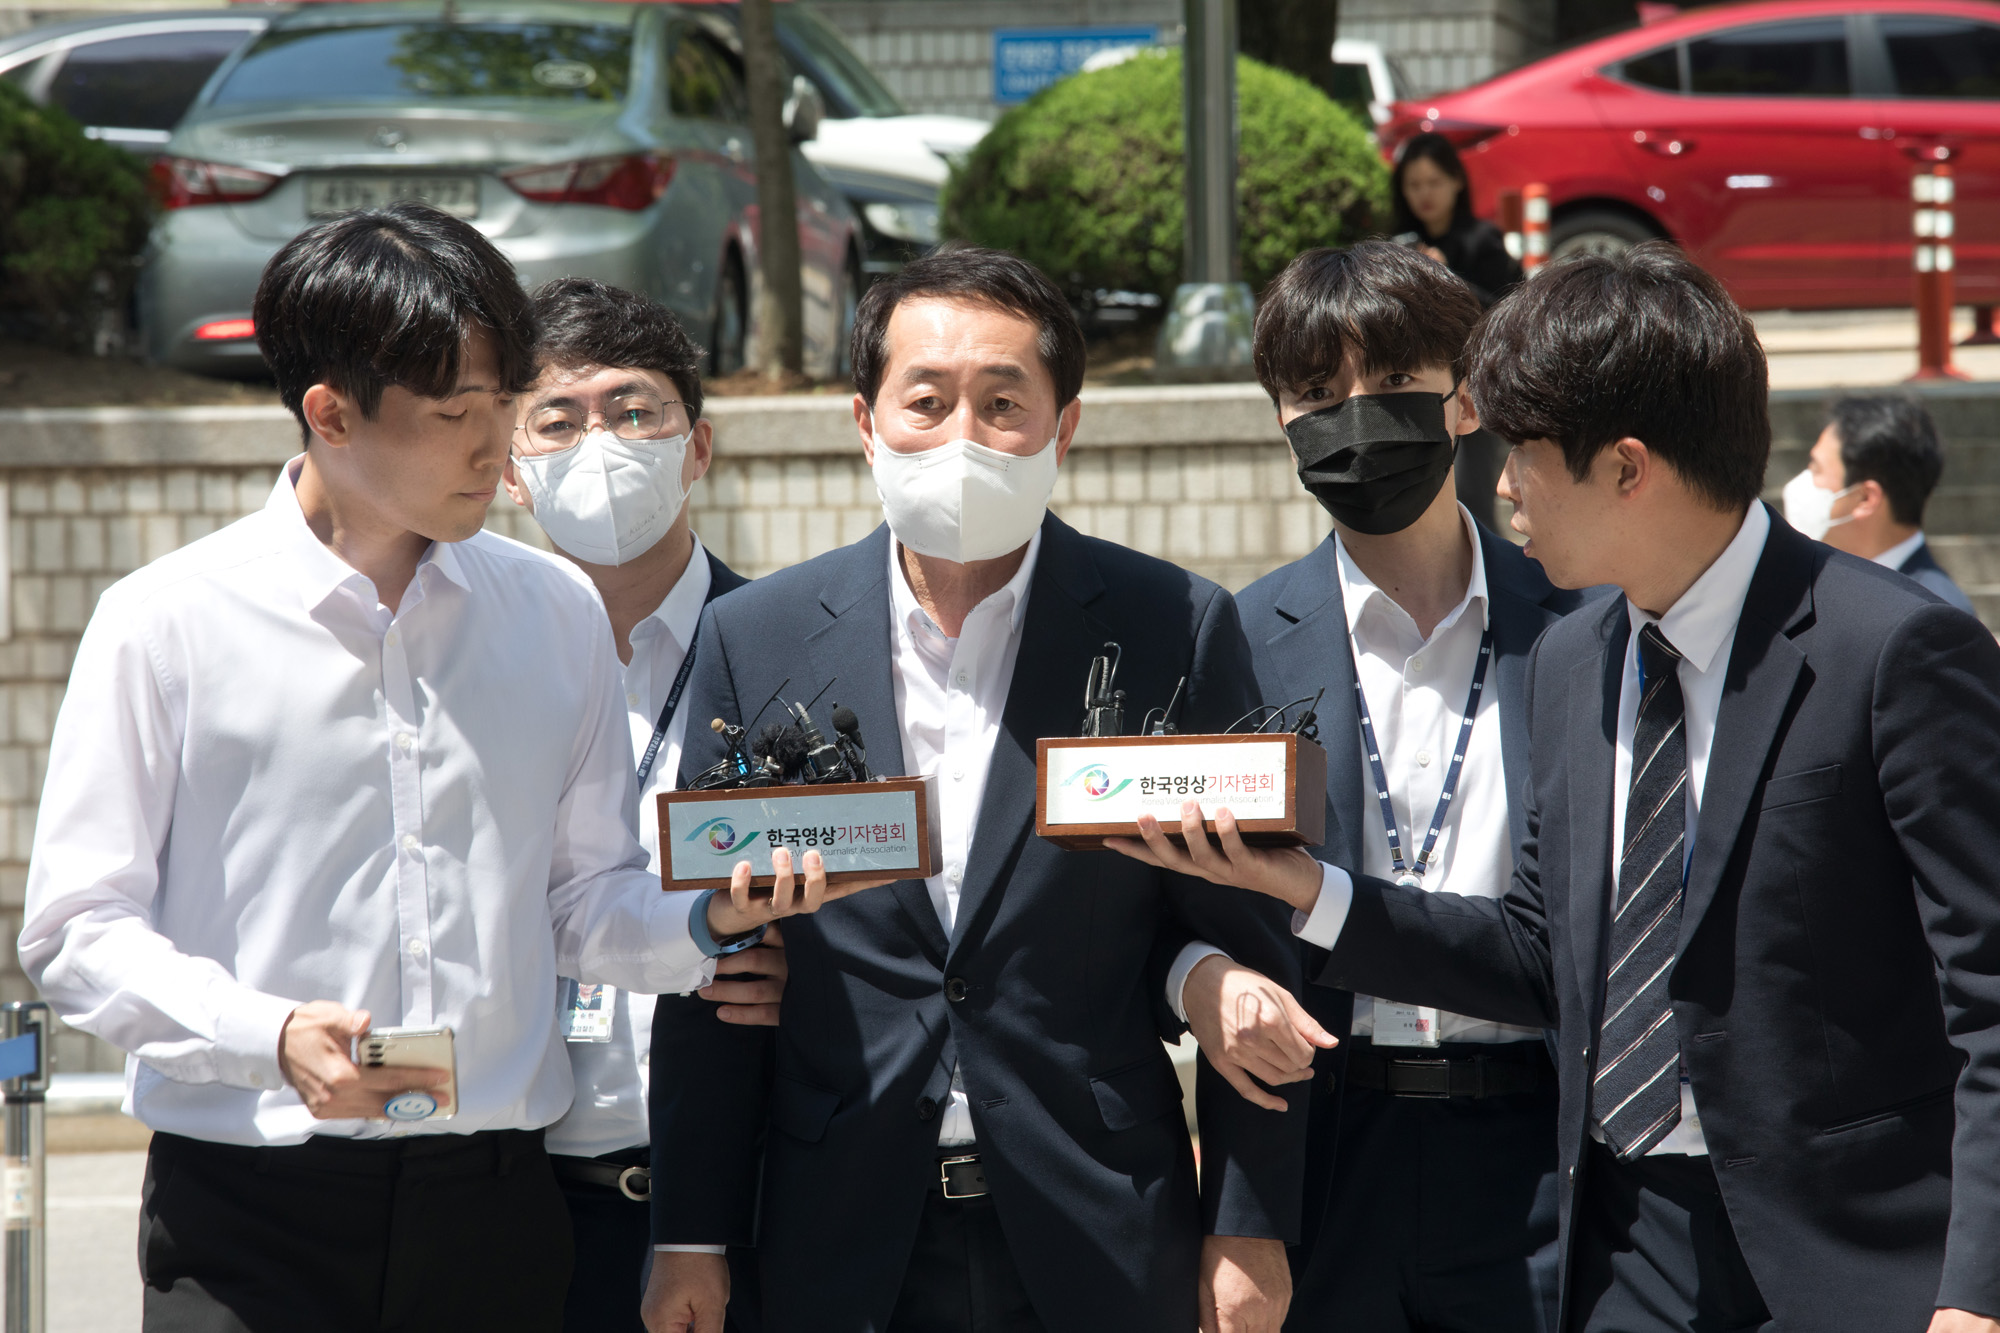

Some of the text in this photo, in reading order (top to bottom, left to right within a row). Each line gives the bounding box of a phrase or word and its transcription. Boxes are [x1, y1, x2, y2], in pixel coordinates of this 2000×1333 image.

[1139, 773, 1274, 795] 한국영상기자협회
[766, 822, 906, 848] 한국영상기자협회
[860, 844, 907, 854] Association
